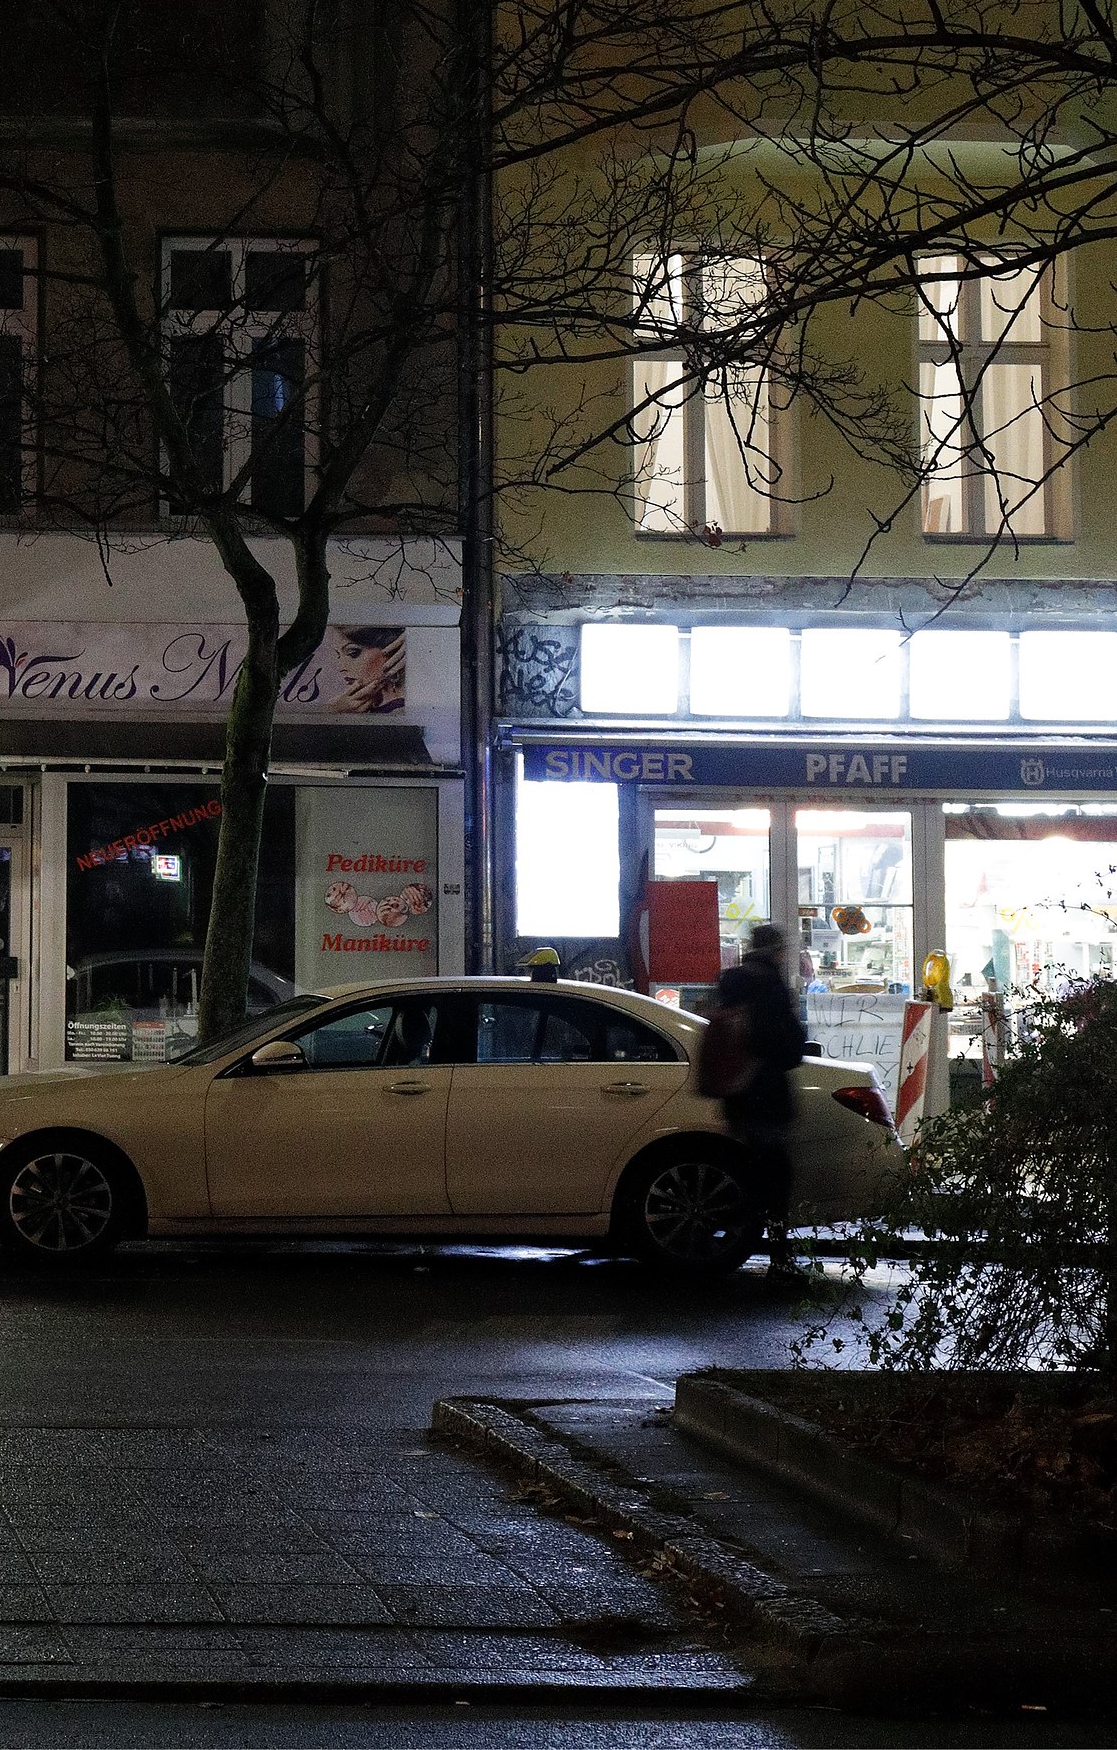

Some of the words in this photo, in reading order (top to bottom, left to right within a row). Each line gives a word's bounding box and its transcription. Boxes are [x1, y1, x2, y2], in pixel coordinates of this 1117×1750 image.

[149, 632, 324, 703] Nls
[545, 750, 696, 781] SINGER
[805, 753, 908, 784] PFAFF
[1045, 766, 1114, 778] Husqvarna
[75, 799, 223, 872] NEUERÖFFNUNG
[325, 853, 428, 873] Pediküre
[321, 932, 431, 953] Maniküre
[67, 1020, 127, 1031] Öffnungszeiten
[813, 994, 884, 1028] WIR
